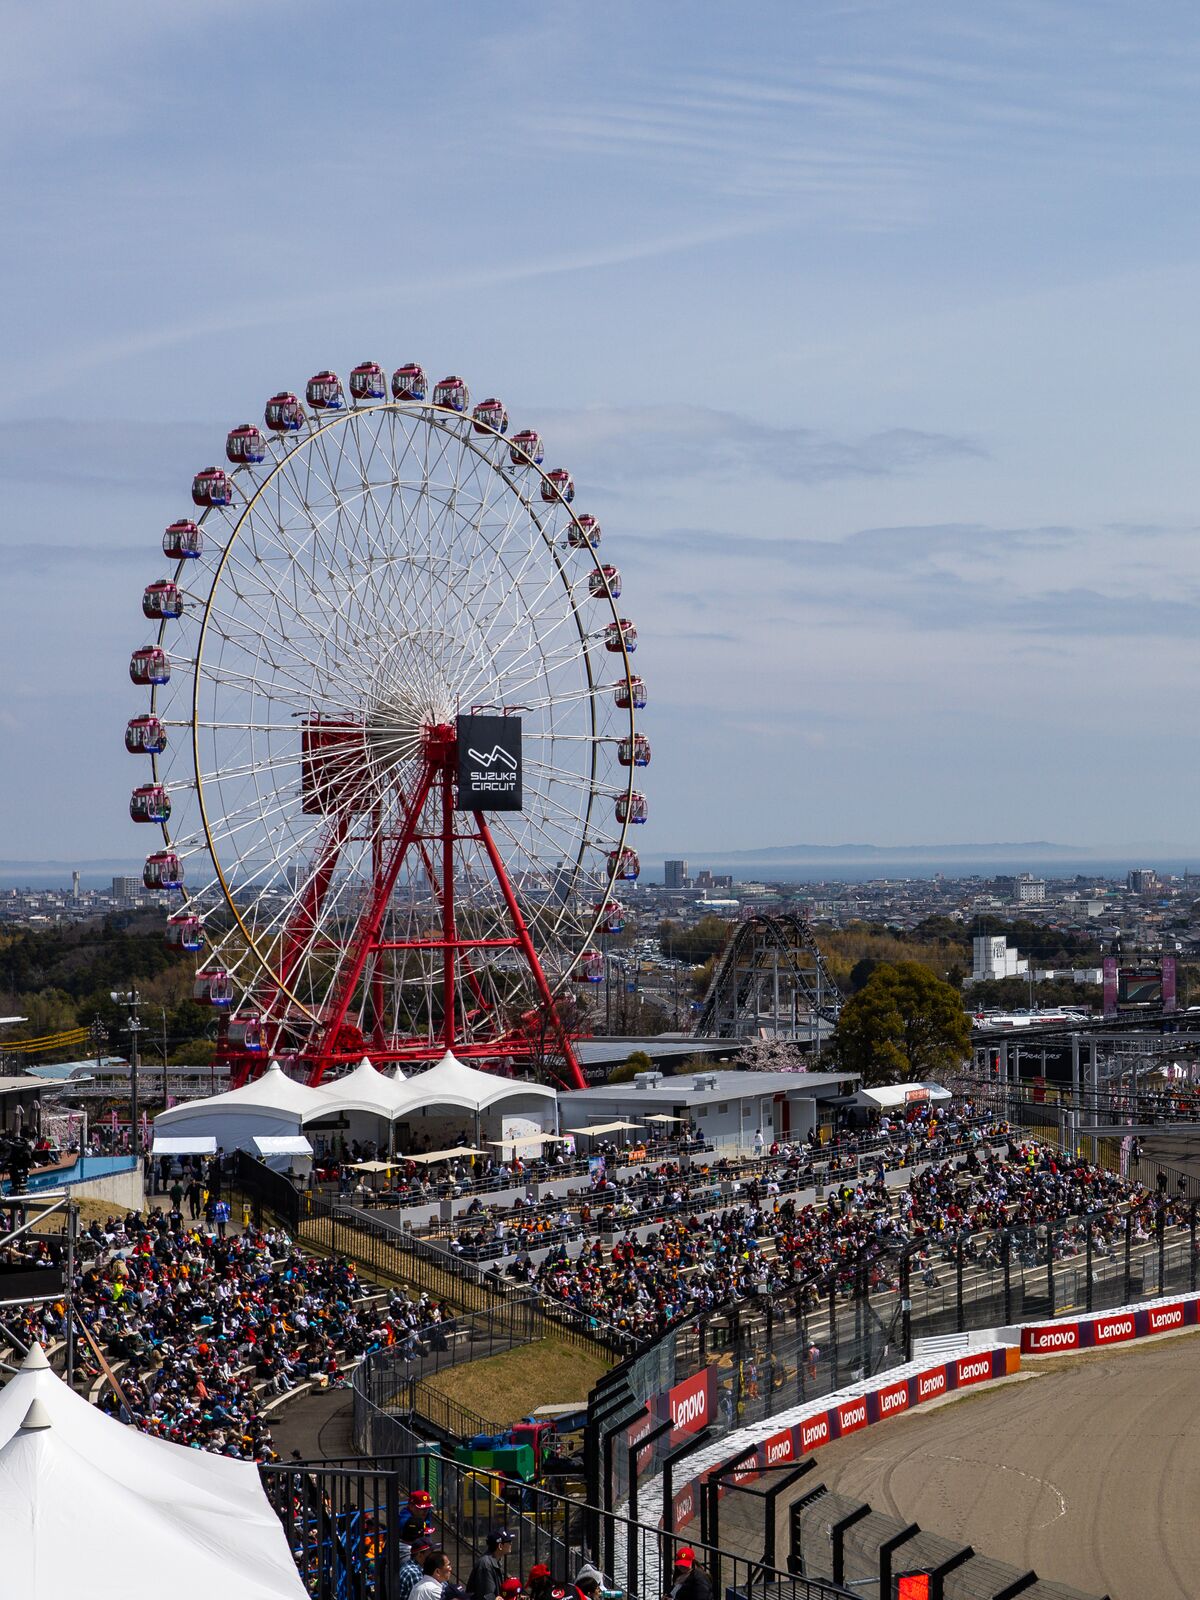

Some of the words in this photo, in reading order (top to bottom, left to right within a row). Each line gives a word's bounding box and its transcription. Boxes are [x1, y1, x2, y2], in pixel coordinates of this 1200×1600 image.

[470, 771, 517, 781] SUZUKA
[471, 782, 516, 791] CIRCUIT
[1151, 1310, 1181, 1328] Lenovo
[1031, 1331, 1075, 1347] Lenovo
[1098, 1322, 1132, 1338] Lenovo
[959, 1361, 989, 1379] Lenovo
[919, 1376, 944, 1394] Lenovo
[881, 1390, 907, 1412] Lenovo
[672, 1390, 705, 1431] Lenovo
[841, 1406, 865, 1429] Lenovo
[802, 1422, 827, 1444] Lenovo
[767, 1441, 791, 1464] Lenovo
